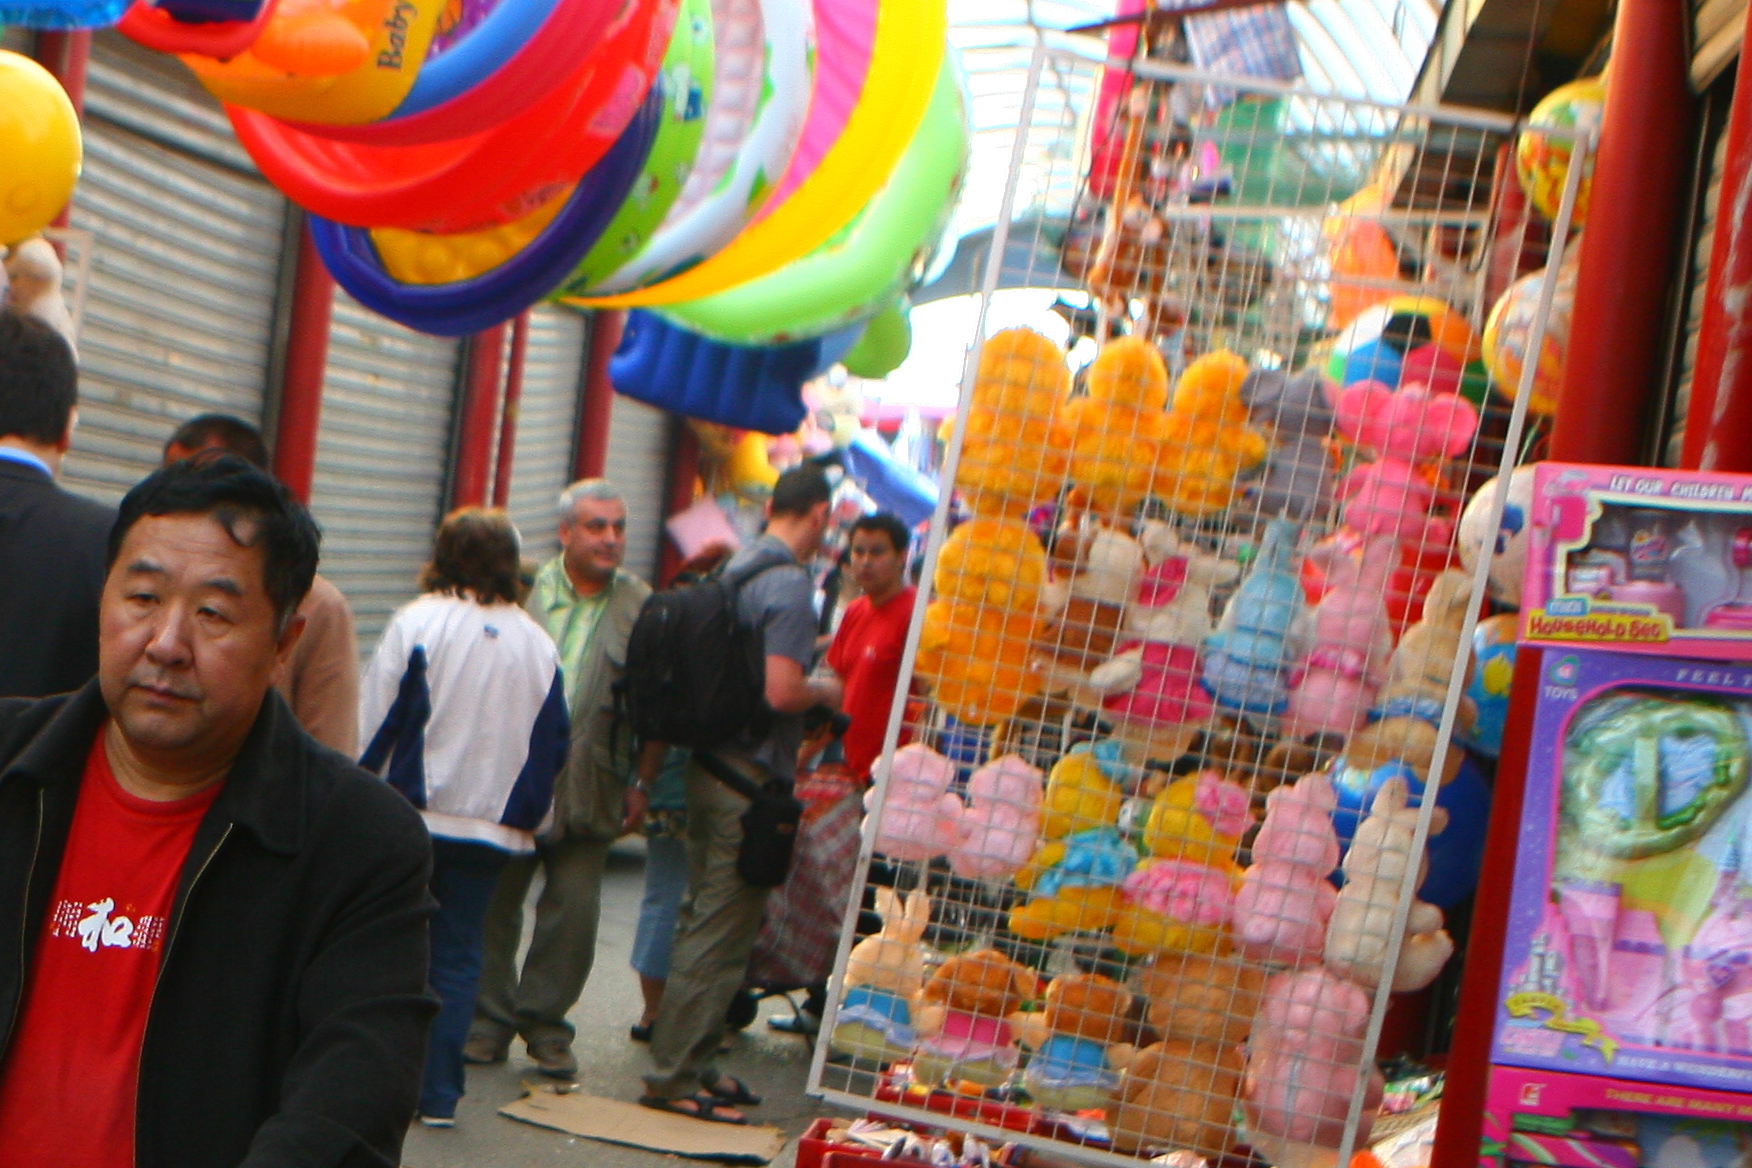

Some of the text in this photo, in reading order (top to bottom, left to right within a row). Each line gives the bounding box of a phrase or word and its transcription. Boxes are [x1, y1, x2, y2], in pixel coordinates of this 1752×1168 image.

[376, 0, 419, 69] Baby
[1609, 473, 1632, 493] LET
[1634, 477, 1663, 495] OUR
[1669, 480, 1735, 501] CHILDREN
[1676, 668, 1735, 687] FEEL
